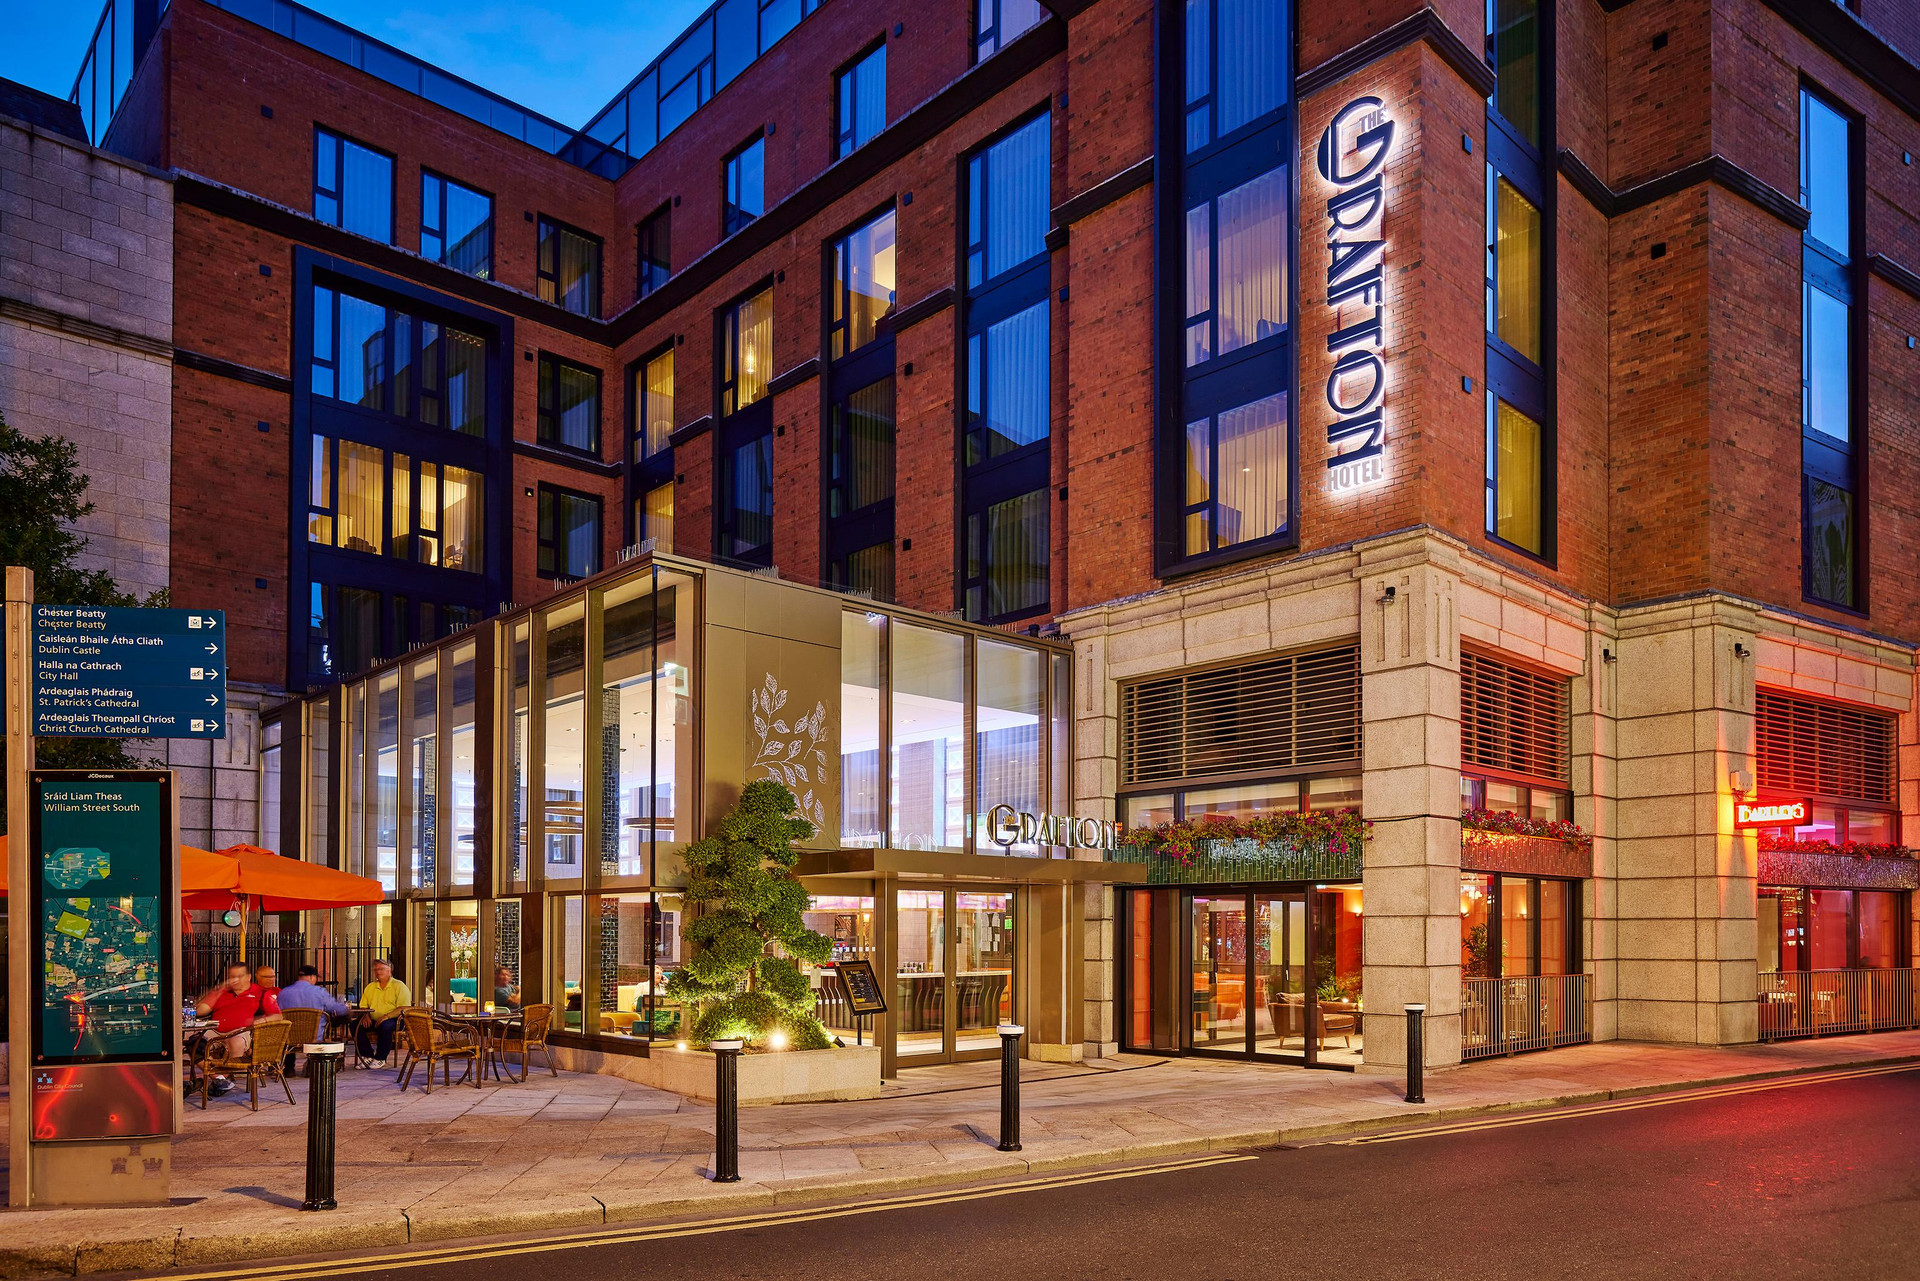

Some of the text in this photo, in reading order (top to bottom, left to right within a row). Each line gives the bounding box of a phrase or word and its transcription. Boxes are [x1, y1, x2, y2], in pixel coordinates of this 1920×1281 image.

[1359, 108, 1386, 133] THE
[1317, 95, 1397, 469] GRAFTON
[1328, 458, 1383, 492] HOTEL
[38, 608, 106, 619] Chester Beatty
[38, 619, 106, 630] Chester Beatty
[39, 635, 163, 645] Caisleán Bhaile Átha Cliath
[40, 661, 63, 669] Halla
[80, 662, 121, 670] Cathrach
[39, 672, 78, 681] City Hall
[39, 687, 132, 698] Ardeaglais Phádraig
[54, 698, 92, 706] Patrick's
[94, 699, 139, 707] Cathedral
[39, 713, 175, 724] Ardeaglais Theampall Chríost
[40, 724, 66, 732] Christ
[69, 725, 101, 733] Church
[44, 792, 122, 801] Sráid Liam Theas
